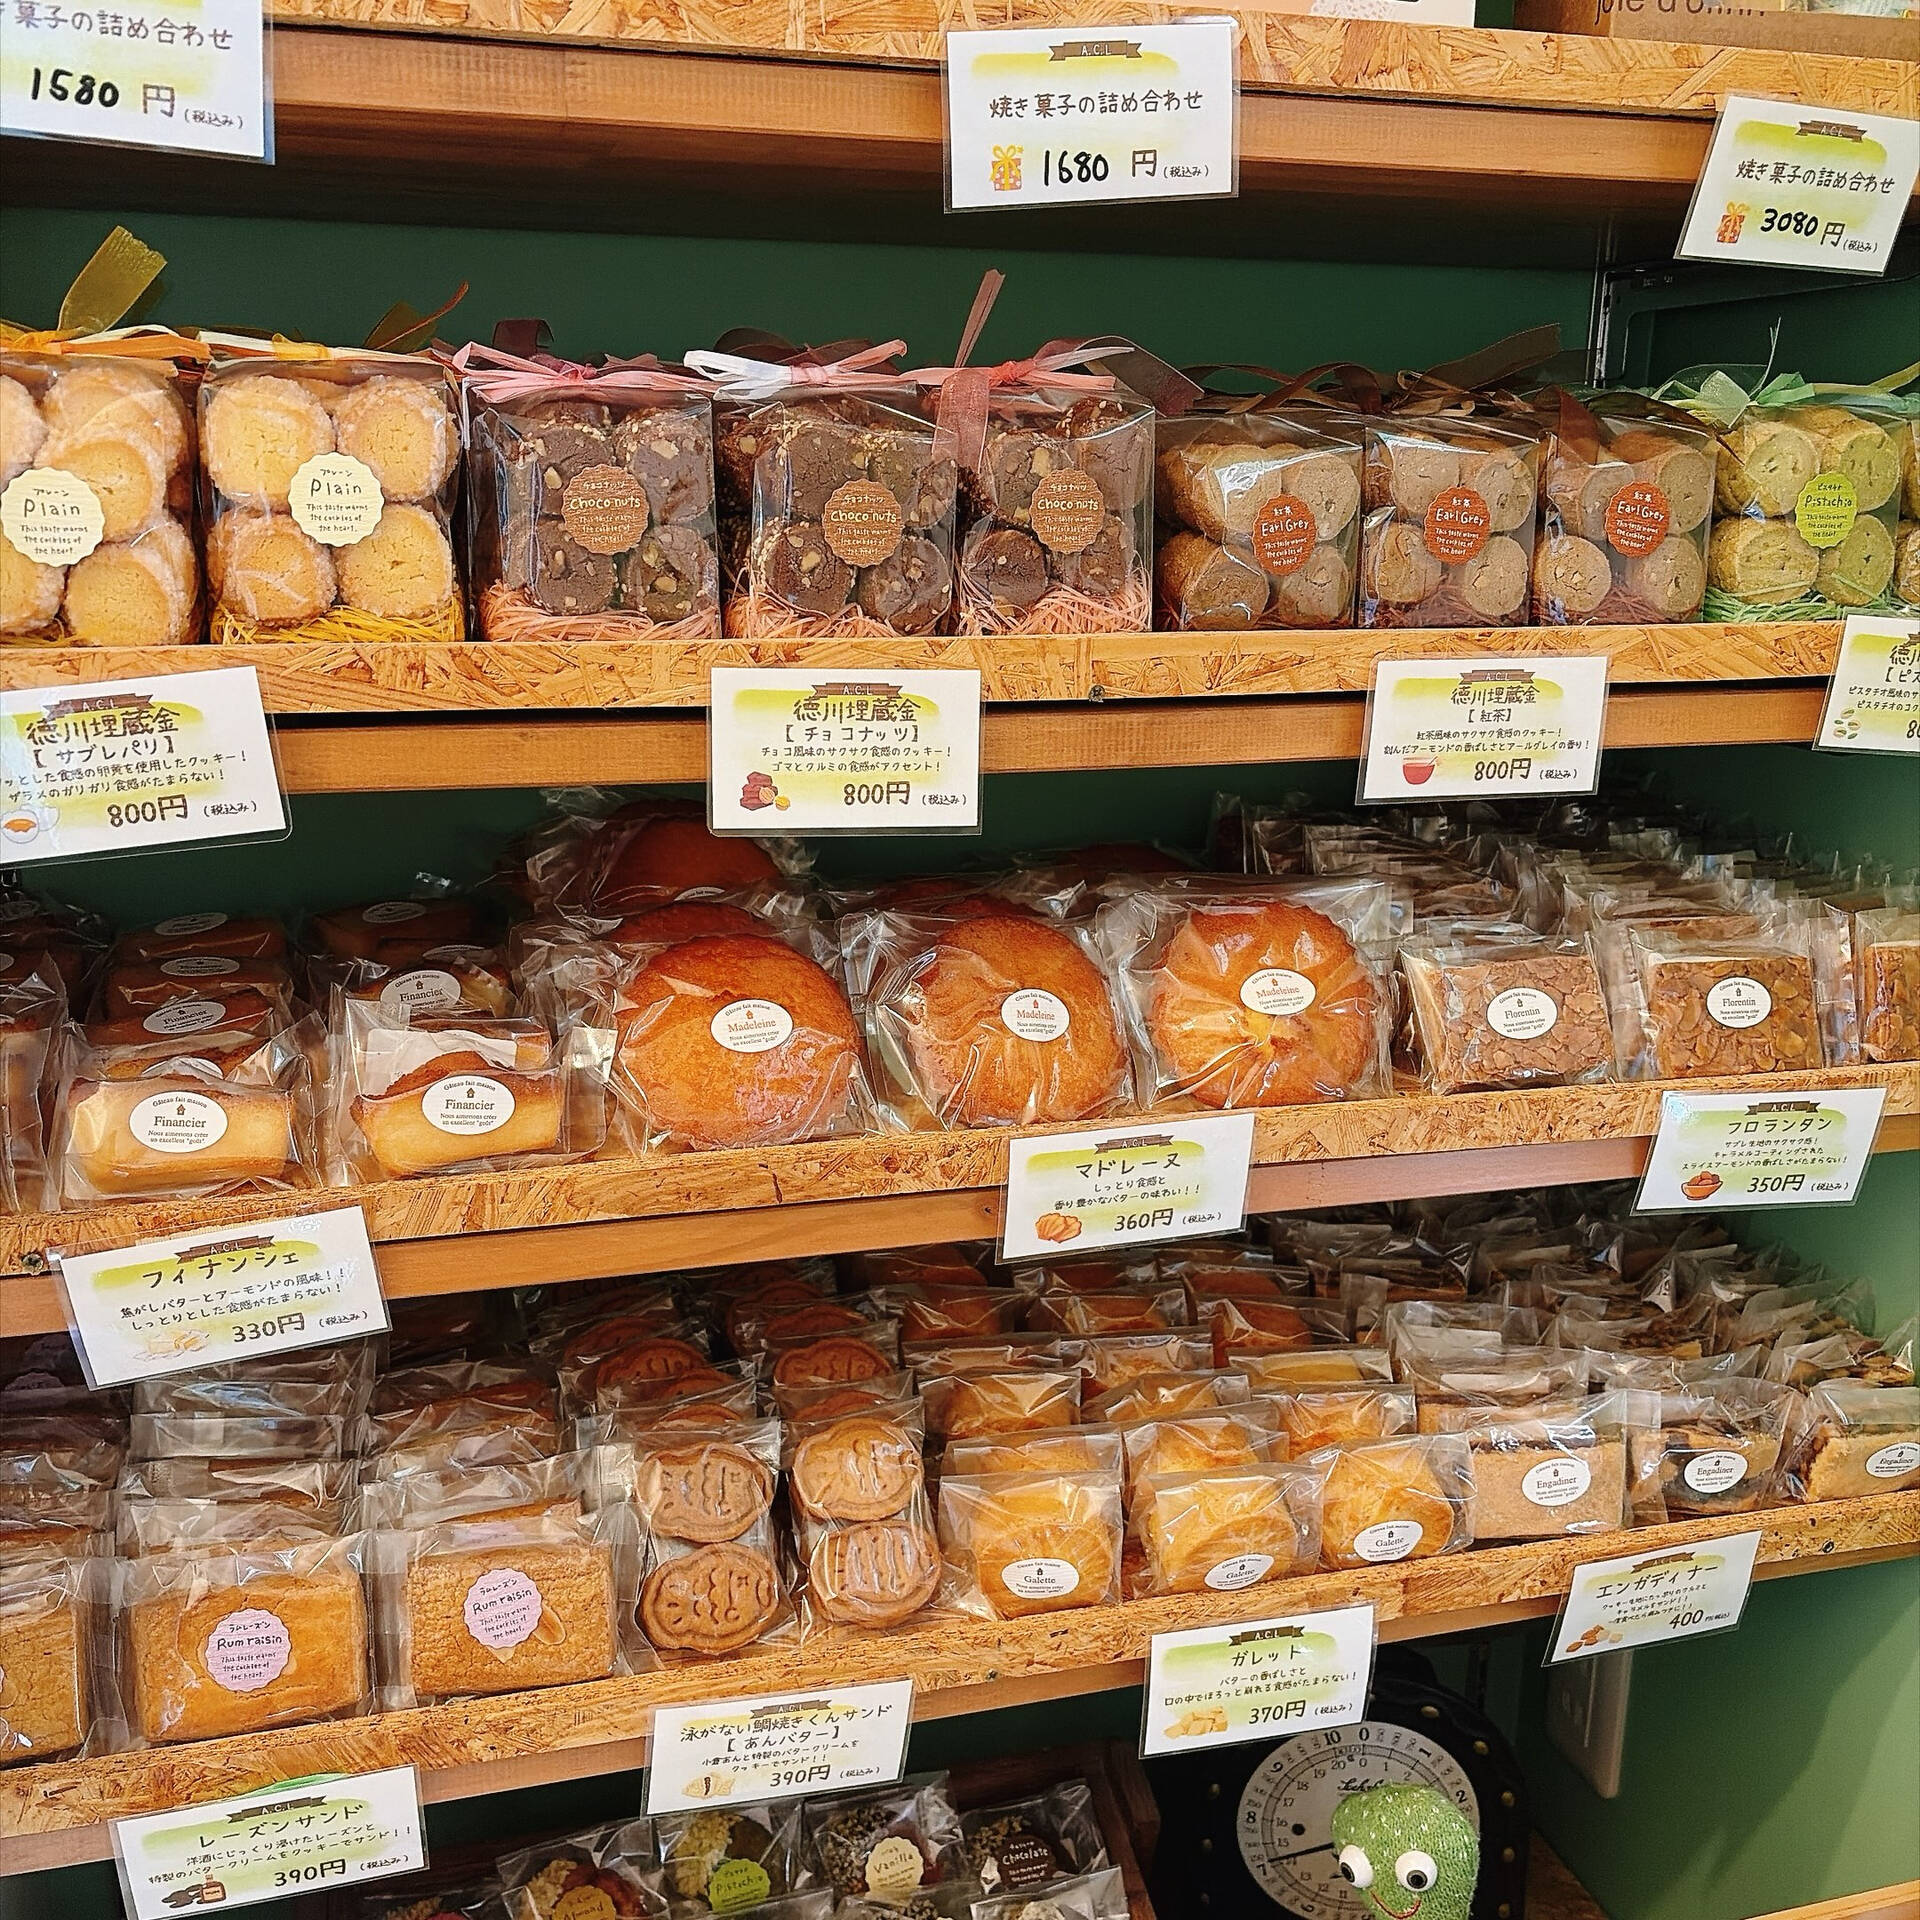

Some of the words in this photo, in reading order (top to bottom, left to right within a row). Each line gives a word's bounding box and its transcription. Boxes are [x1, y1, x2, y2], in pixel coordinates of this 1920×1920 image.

[0, 1, 233, 50] 菓子の詰め合わせ
[32, 68, 119, 107] 1580
[142, 84, 175, 117] 円
[989, 89, 1203, 119] 焼き菓子の詰め合わせ
[1043, 150, 1109, 186] 1680
[1132, 150, 1157, 177] 円
[1735, 158, 1895, 194] 焼き菓子の詰め合わせ
[1760, 208, 1818, 237] 3080
[1820, 222, 1846, 247] 円
[310, 478, 362, 497] Plain
[24, 498, 80, 517] Plain
[1804, 494, 1852, 508] Pistachio
[1451, 684, 1540, 706] 徳川埋蔵金
[793, 697, 922, 724] 徳川埋蔵金
[1468, 708, 1512, 723] 【紅茶】
[26, 706, 180, 745] 徳川埋蔵金
[786, 724, 919, 743] 【チョコナッツ】
[33, 735, 174, 768] 【サブレパリ】
[761, 745, 951, 758] チョコ風味のサクサク食感のクッキー！
[0, 751, 247, 787] ッとした食感の卵黄を使用したクッキー！
[772, 761, 940, 773] ゴマとクルミの食感がアクセント！
[1474, 758, 1532, 781] 800円
[843, 781, 911, 805] 800円
[107, 794, 189, 827] 800円
[1256, 986, 1300, 999] Madeleine
[727, 1019, 777, 1033] Madeleine
[1016, 1009, 1055, 1020] Madeleine
[445, 1099, 495, 1110] Financier
[153, 1115, 207, 1128] Financier
[1728, 1117, 1832, 1135] フロランタン
[1075, 1152, 1181, 1179] マドレーヌ
[1094, 1175, 1166, 1193] しっとり食感と
[1747, 1174, 1805, 1193] 350円
[1114, 1207, 1174, 1232] 360円
[142, 1250, 299, 1290] フィナンシェ
[232, 1312, 305, 1344] 330円
[1596, 1565, 1718, 1599] エンガディナー
[472, 1600, 498, 1615] Rum
[500, 1589, 532, 1604] raisin
[1669, 1609, 1704, 1629] 400
[217, 1638, 244, 1651] Rum
[247, 1635, 282, 1646] raisin
[1232, 1645, 1302, 1667] ガレット
[1219, 1666, 1307, 1687] バターの香ばしさと
[680, 1704, 892, 1742] 泳がない鯛焼きくんサンド
[1249, 1700, 1306, 1724] 370円
[727, 1726, 840, 1753] 【あんバター】
[770, 1764, 831, 1787] 390円
[199, 1803, 364, 1848] レーズンサンド
[274, 1858, 345, 1888] 390円
